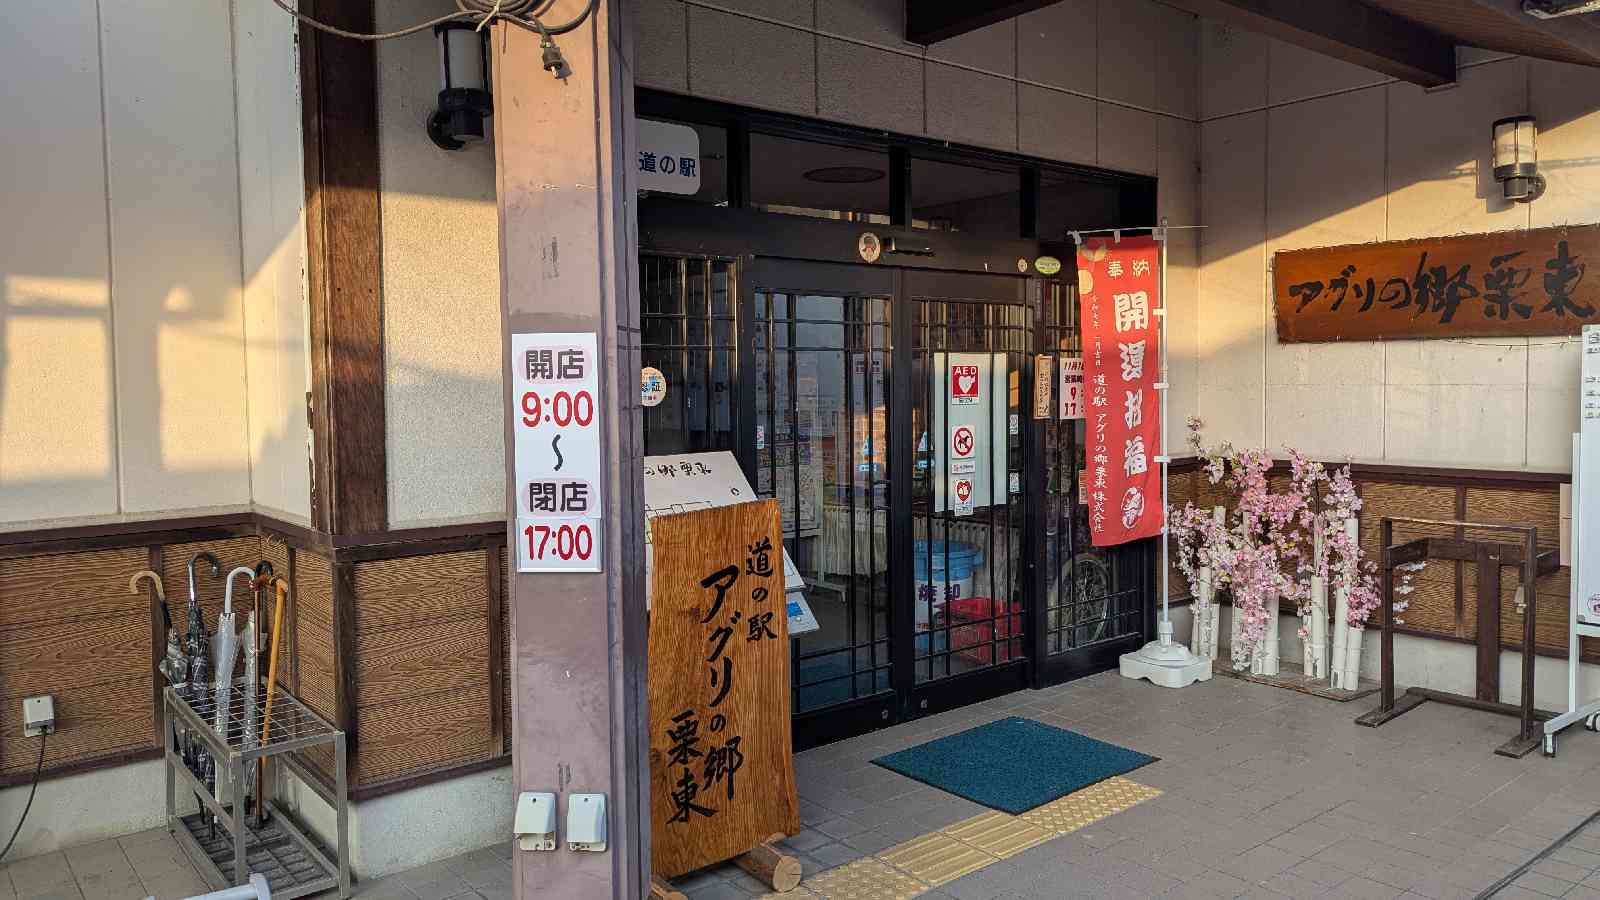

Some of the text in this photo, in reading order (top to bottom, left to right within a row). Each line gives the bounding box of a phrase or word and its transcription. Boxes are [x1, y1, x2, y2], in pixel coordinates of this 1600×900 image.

[639, 152, 697, 178] 道の駅
[1106, 259, 1150, 278] 奉納
[1288, 240, 1598, 324] アグリの郷栗東
[525, 349, 584, 380] 開店
[954, 366, 977, 376] AED
[1064, 374, 1085, 384] 営業時
[1092, 373, 1108, 407] 道の駅
[521, 390, 594, 428] 9:00
[529, 481, 588, 513] 閉店
[1092, 491, 1107, 533] 株式会社
[524, 523, 593, 562] 17:00
[745, 536, 778, 643] 道の駅
[699, 564, 746, 802] アグリの郷
[667, 708, 719, 825] 栗東
